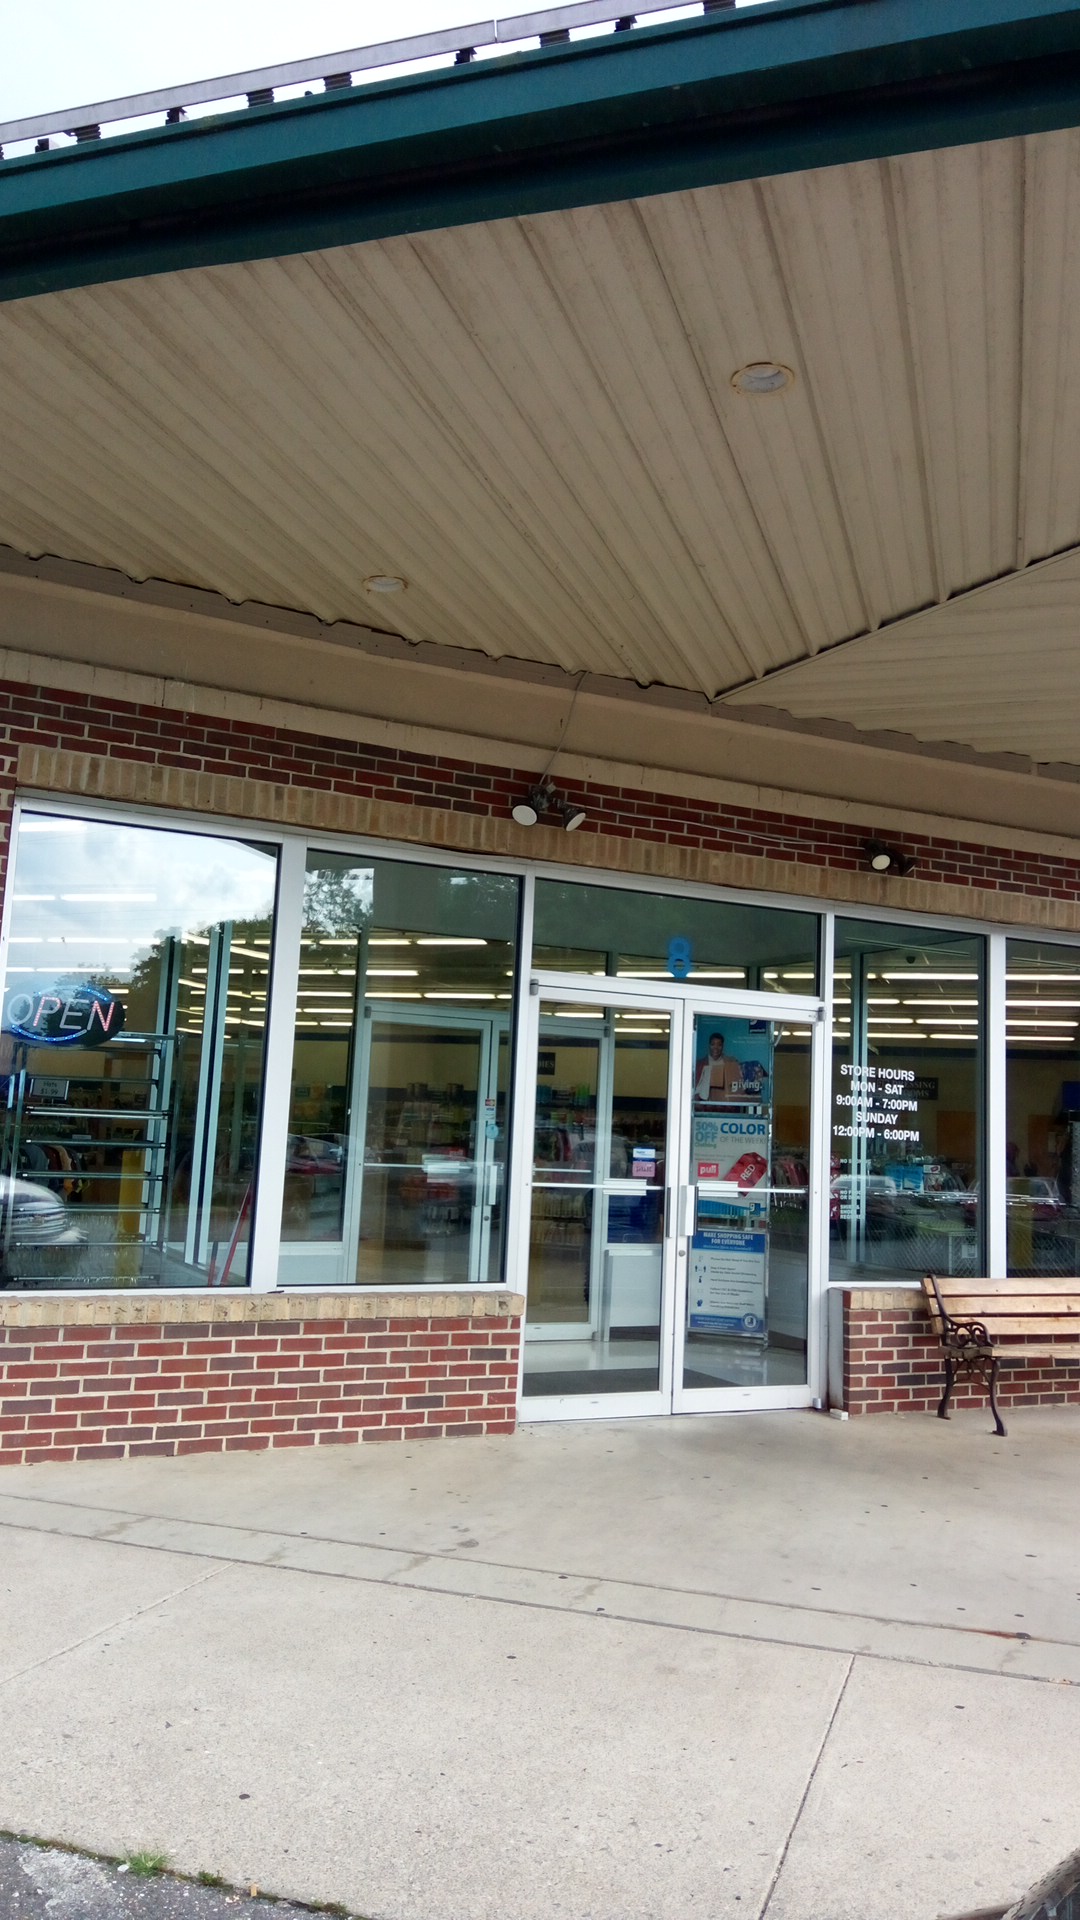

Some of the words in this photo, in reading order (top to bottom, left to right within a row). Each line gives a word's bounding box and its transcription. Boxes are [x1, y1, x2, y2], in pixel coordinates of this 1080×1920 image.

[668, 936, 691, 979] 8
[7, 993, 115, 1032] OPEN
[840, 1064, 876, 1078] STORE
[878, 1067, 915, 1082] HOURS
[850, 1080, 876, 1093] MON
[884, 1083, 904, 1096] SAT
[836, 1094, 874, 1108] 9:00AM
[882, 1098, 918, 1112] 7:00PM
[855, 1111, 899, 1125] SUNDAY
[695, 1121, 718, 1132] 50%
[720, 1122, 766, 1135] COLOR
[832, 1125, 875, 1139] 12:00PM
[883, 1128, 920, 1142] 6:00PM
[694, 1131, 718, 1143] OFF
[740, 1164, 756, 1181] RED
[717, 1232, 742, 1240] SHOPPING
